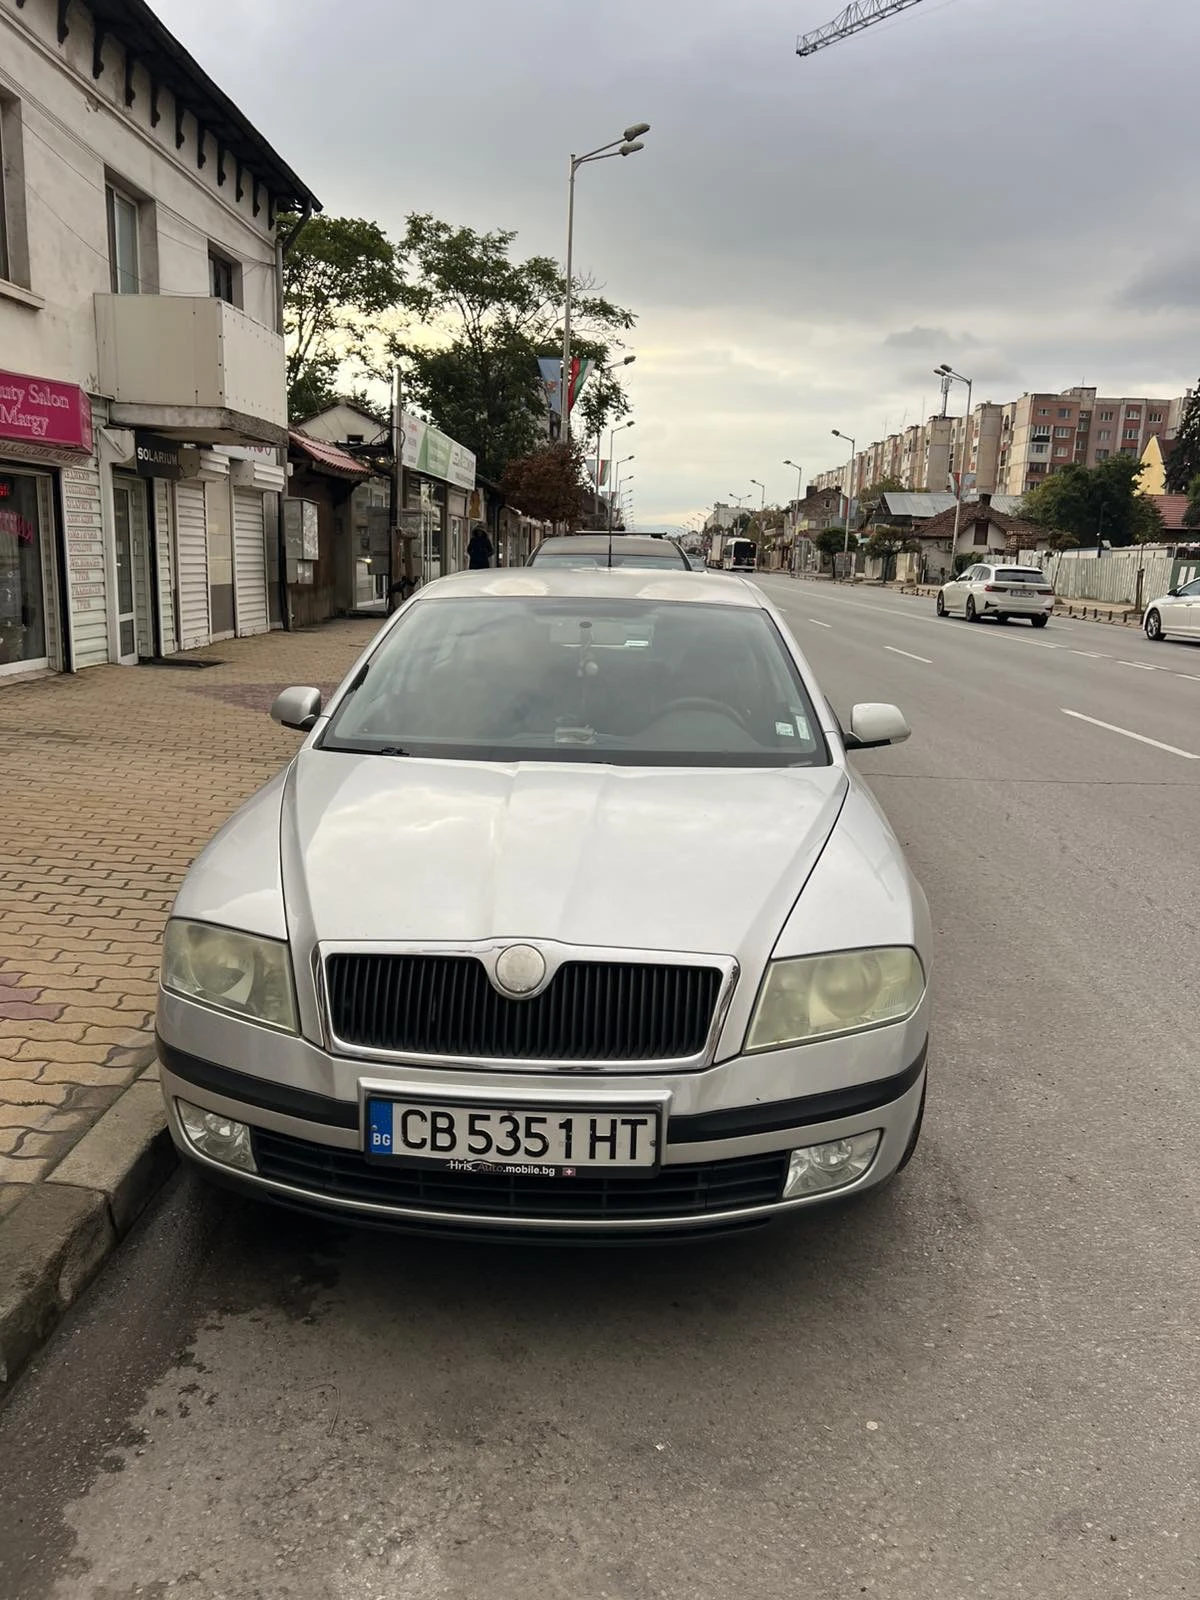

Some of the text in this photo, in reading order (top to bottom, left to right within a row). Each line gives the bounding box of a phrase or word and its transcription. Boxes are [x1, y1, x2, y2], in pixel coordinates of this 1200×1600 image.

[28, 384, 70, 409] Salon
[0, 403, 49, 436] Margy
[137, 447, 178, 466] SOLARIUM
[372, 1132, 391, 1146] BG
[401, 1108, 648, 1160] CB 5351 HT
